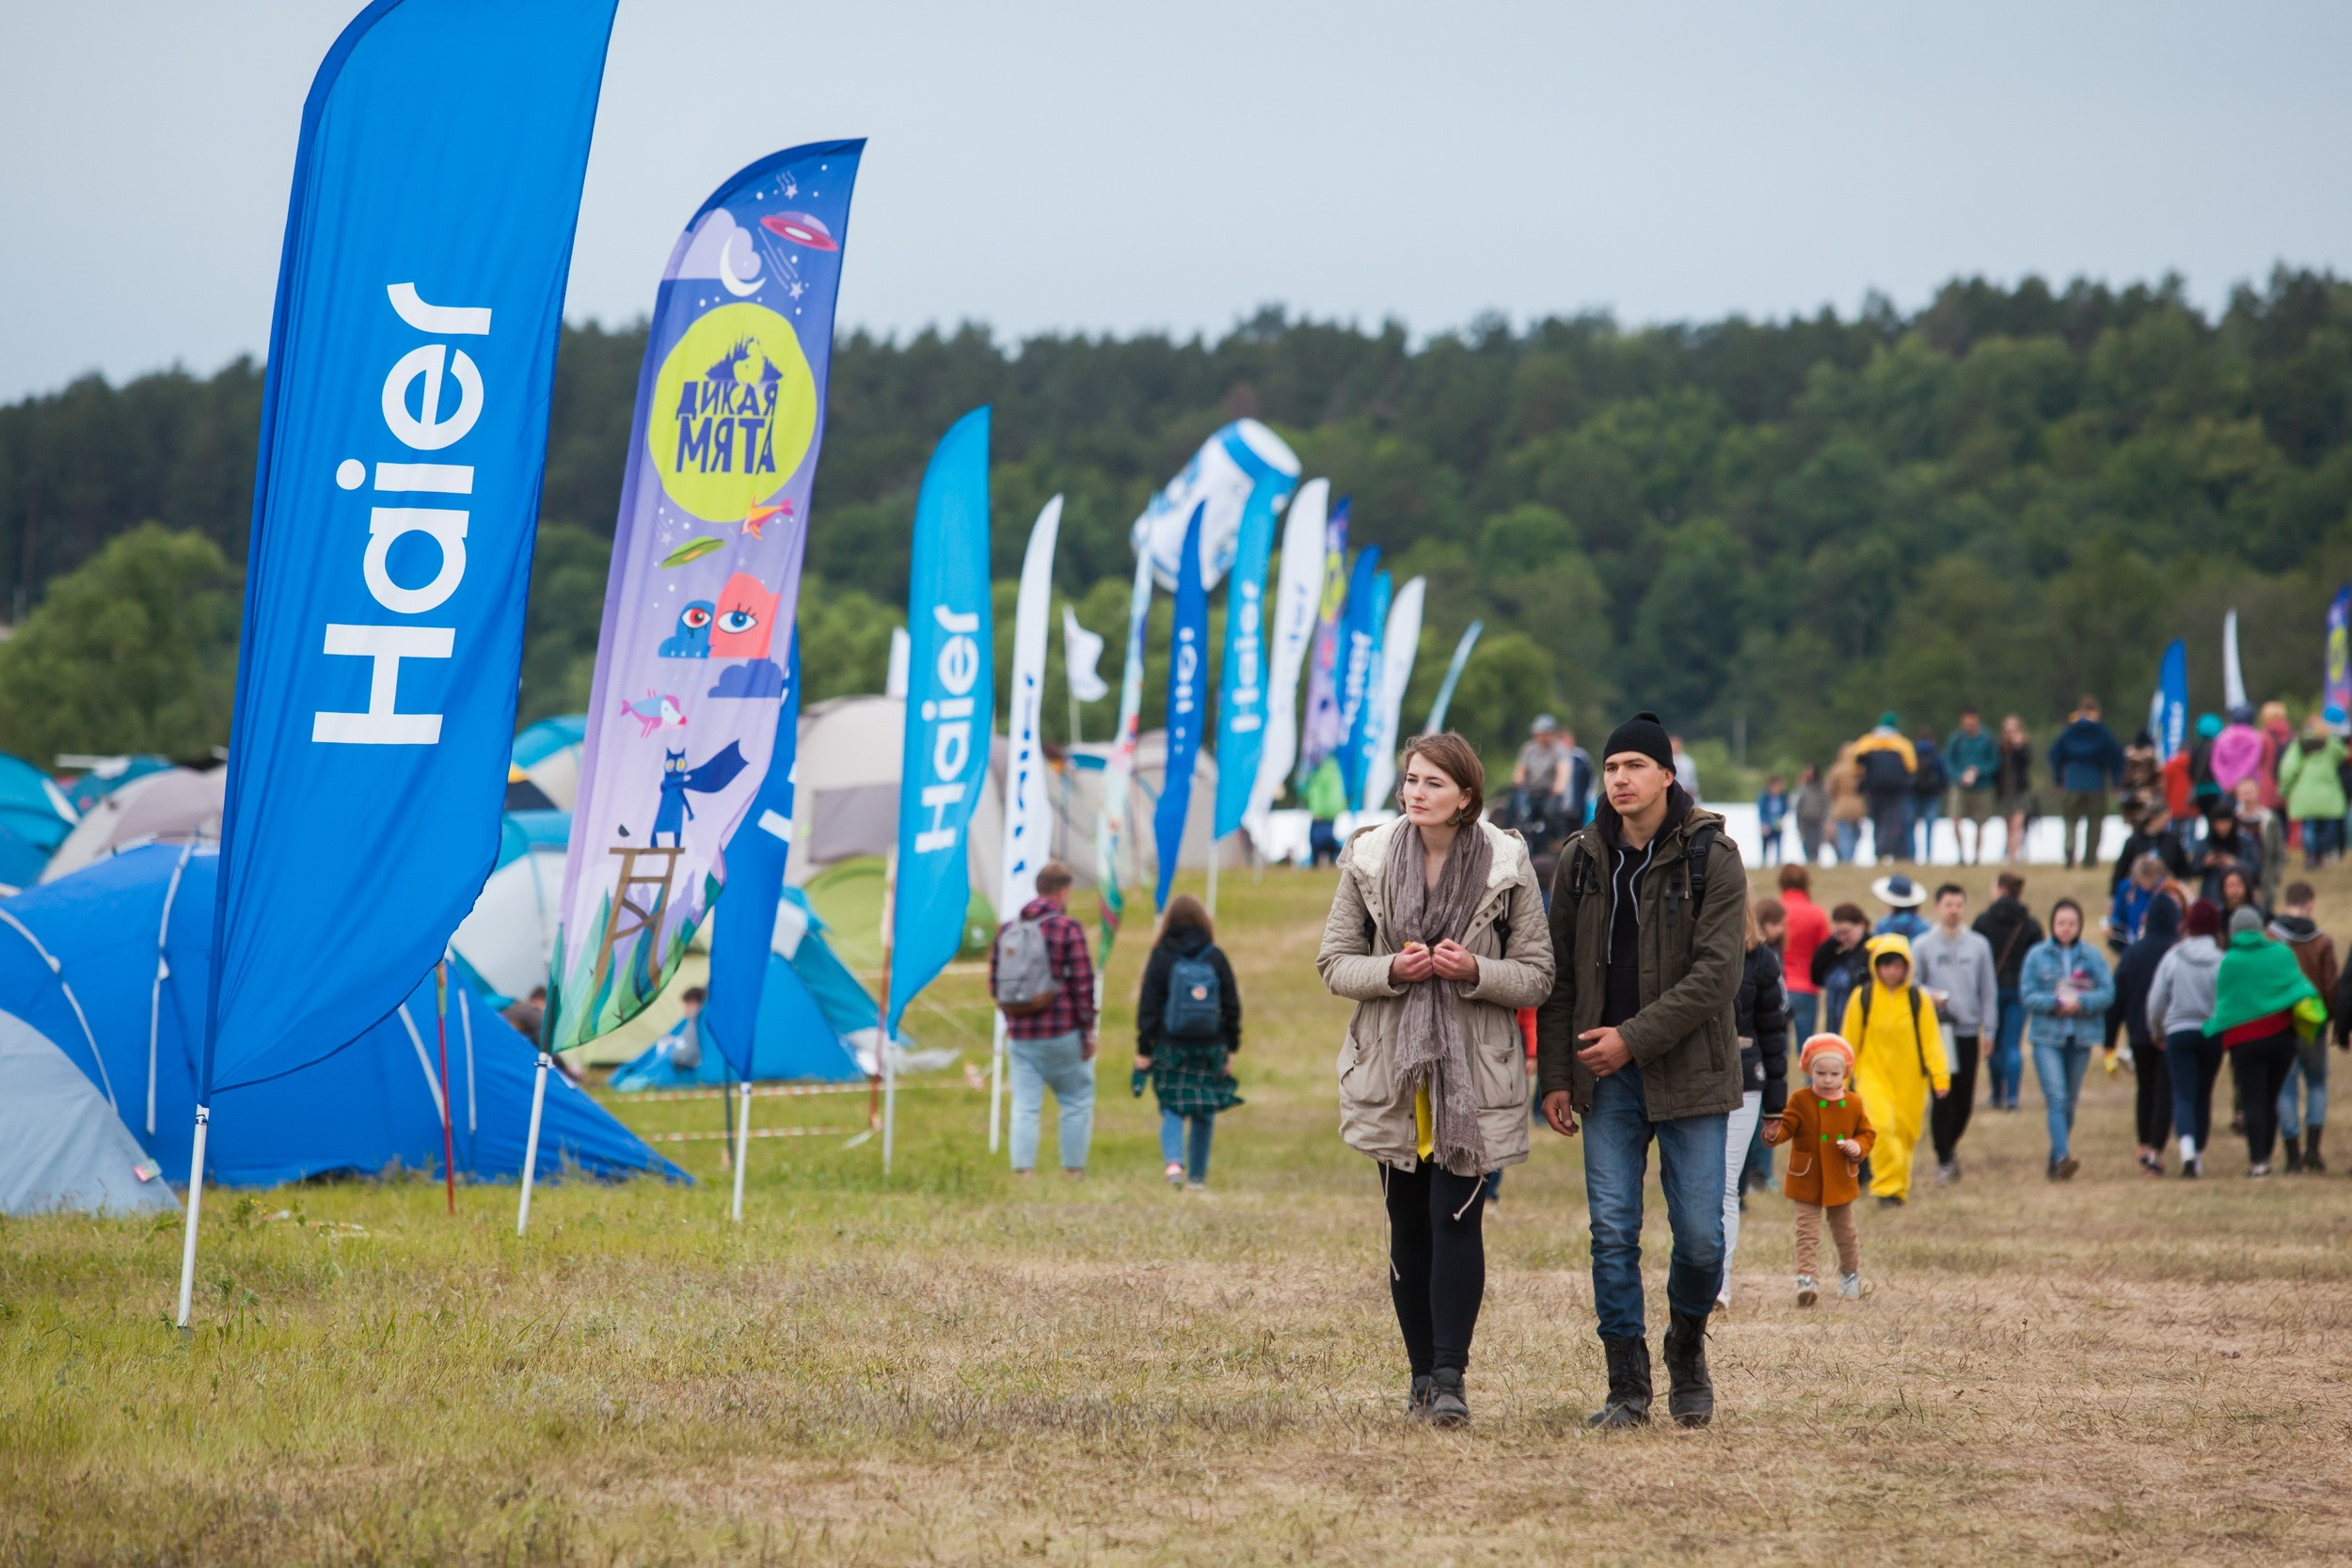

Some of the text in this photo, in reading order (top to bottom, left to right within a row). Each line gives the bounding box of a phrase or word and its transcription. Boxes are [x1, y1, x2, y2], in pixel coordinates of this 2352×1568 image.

[675, 381, 779, 420] ДИКАЯ
[675, 417, 776, 475] МЯТА
[311, 281, 492, 745] Haier
[914, 604, 980, 853] Haier
